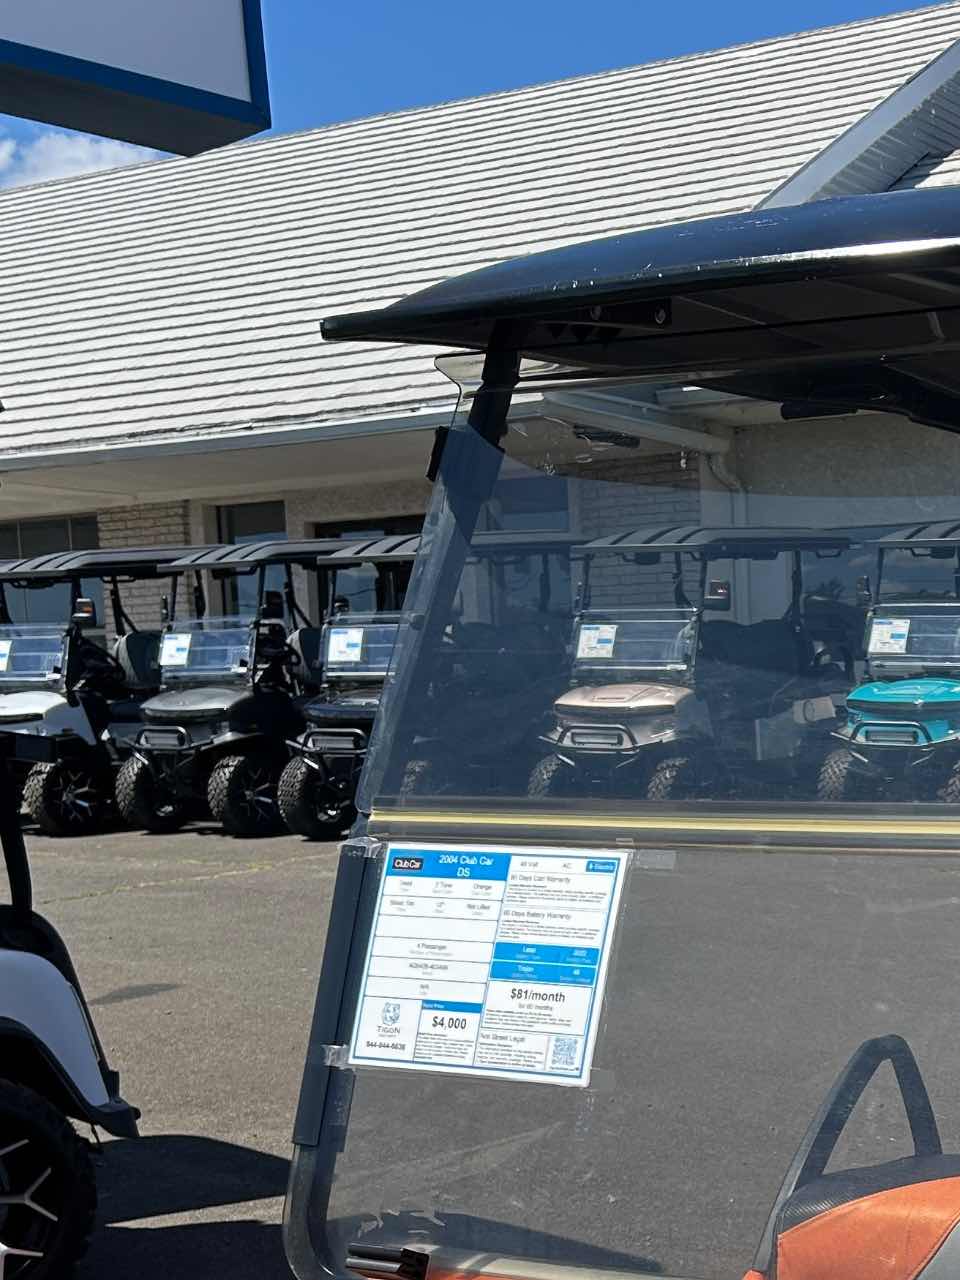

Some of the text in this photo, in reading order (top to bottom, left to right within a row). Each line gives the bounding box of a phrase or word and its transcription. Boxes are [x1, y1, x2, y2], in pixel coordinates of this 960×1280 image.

[394, 858, 422, 869] Club Car
[460, 855, 477, 865] Club
[479, 857, 494, 866] Car
[456, 867, 471, 877] DS
[510, 988, 566, 1002] $81/month
[432, 1016, 466, 1030] $4,000
[377, 1026, 400, 1034] TIGON
